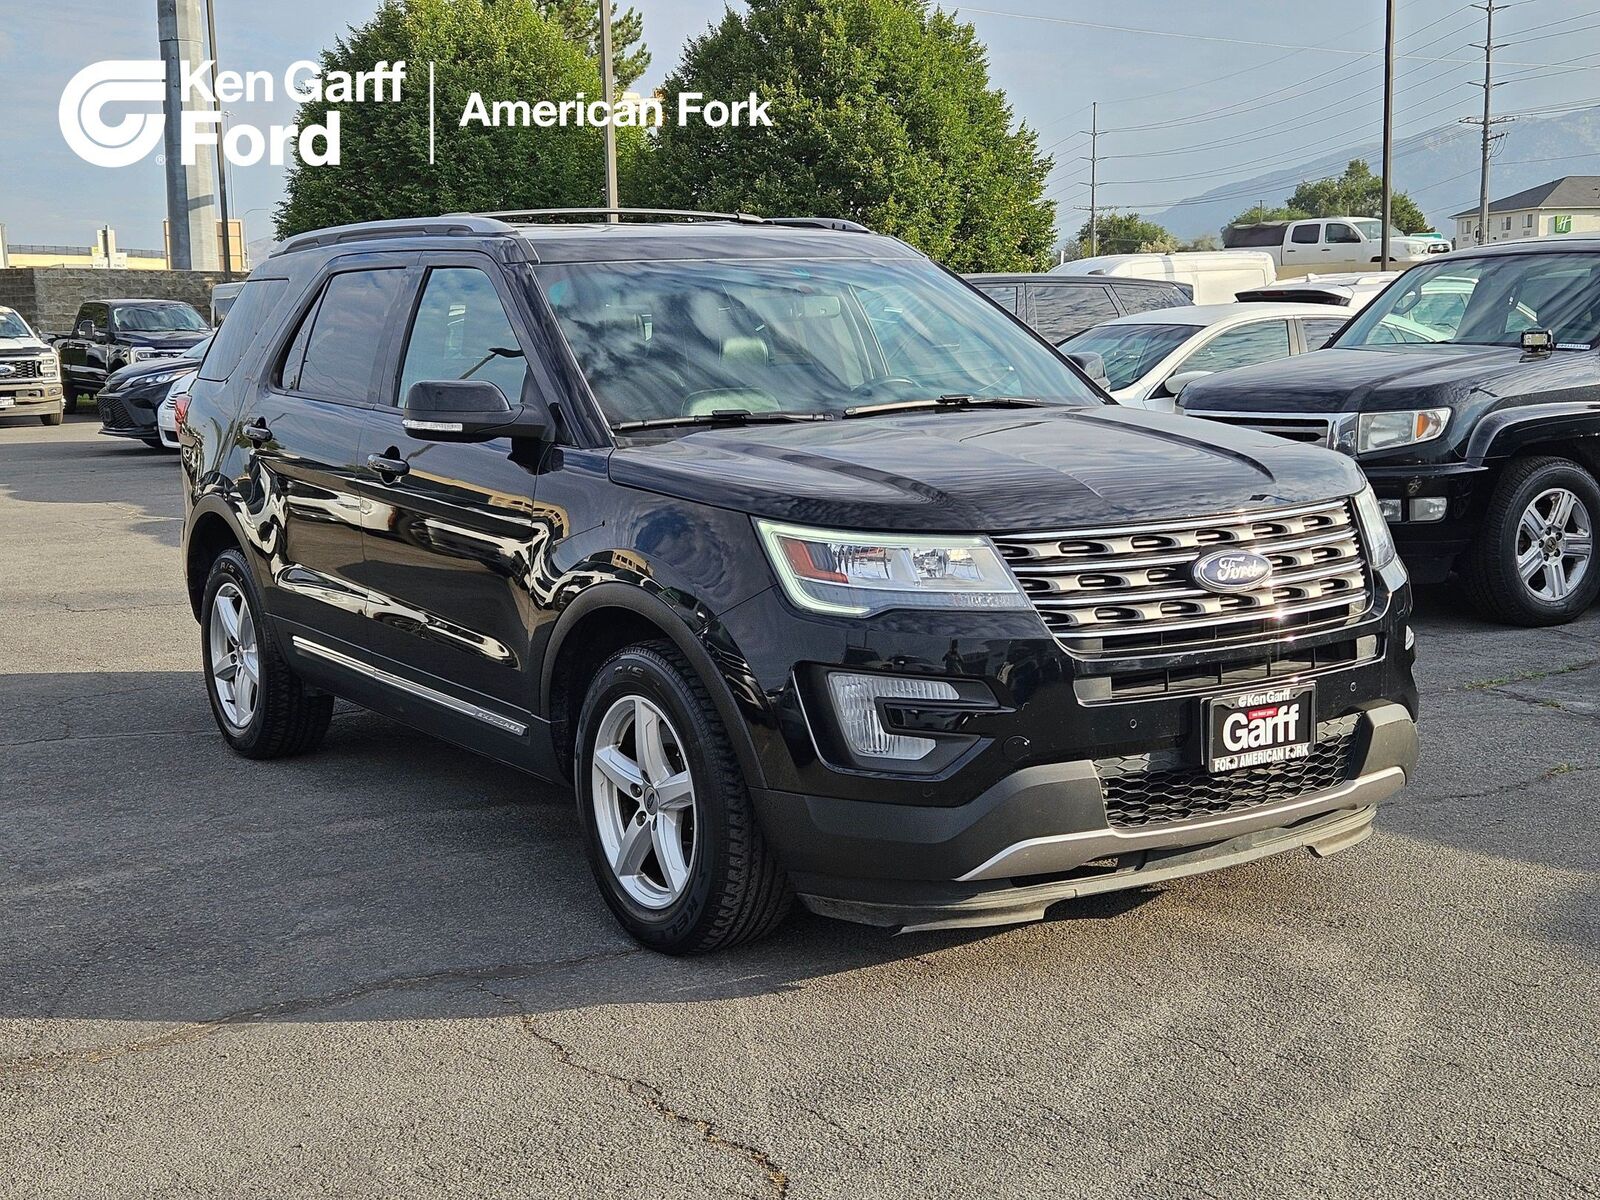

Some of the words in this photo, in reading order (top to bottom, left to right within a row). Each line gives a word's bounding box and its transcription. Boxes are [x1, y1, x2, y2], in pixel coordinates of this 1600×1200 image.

[1217, 556, 1257, 581] Ford
[1222, 704, 1300, 752] Garff
[1214, 758, 1239, 773] FORD
[1239, 747, 1285, 768] AMERICAN
